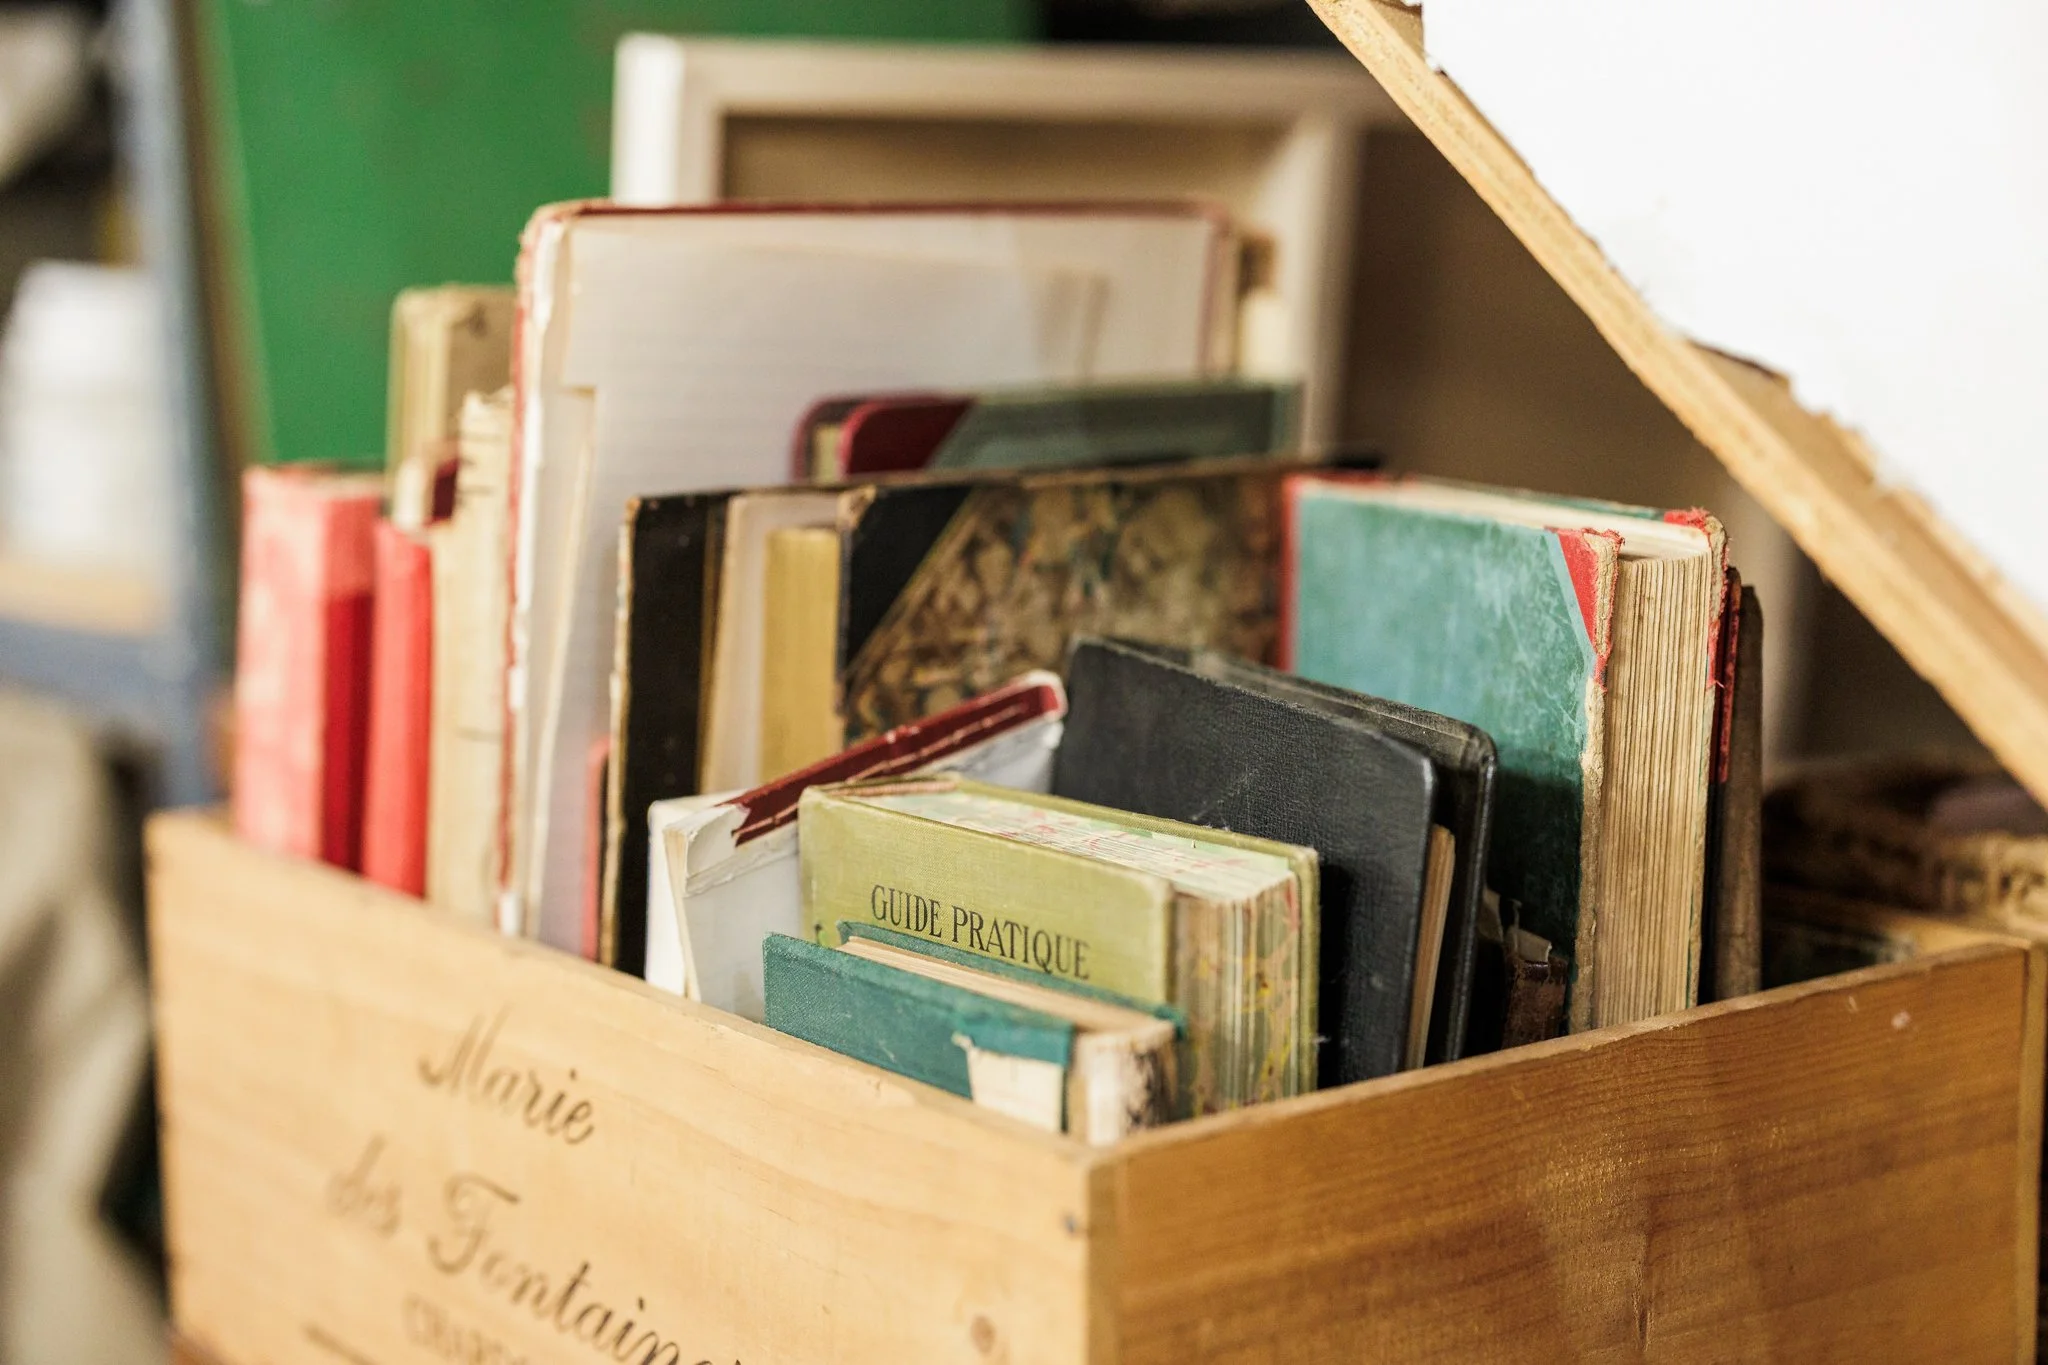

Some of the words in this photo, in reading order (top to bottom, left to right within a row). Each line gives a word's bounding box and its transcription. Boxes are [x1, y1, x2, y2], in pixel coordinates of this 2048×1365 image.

[871, 884, 942, 938] GUIDE
[952, 904, 1090, 980] PRATIQUE
[417, 1000, 595, 1145] Marie
